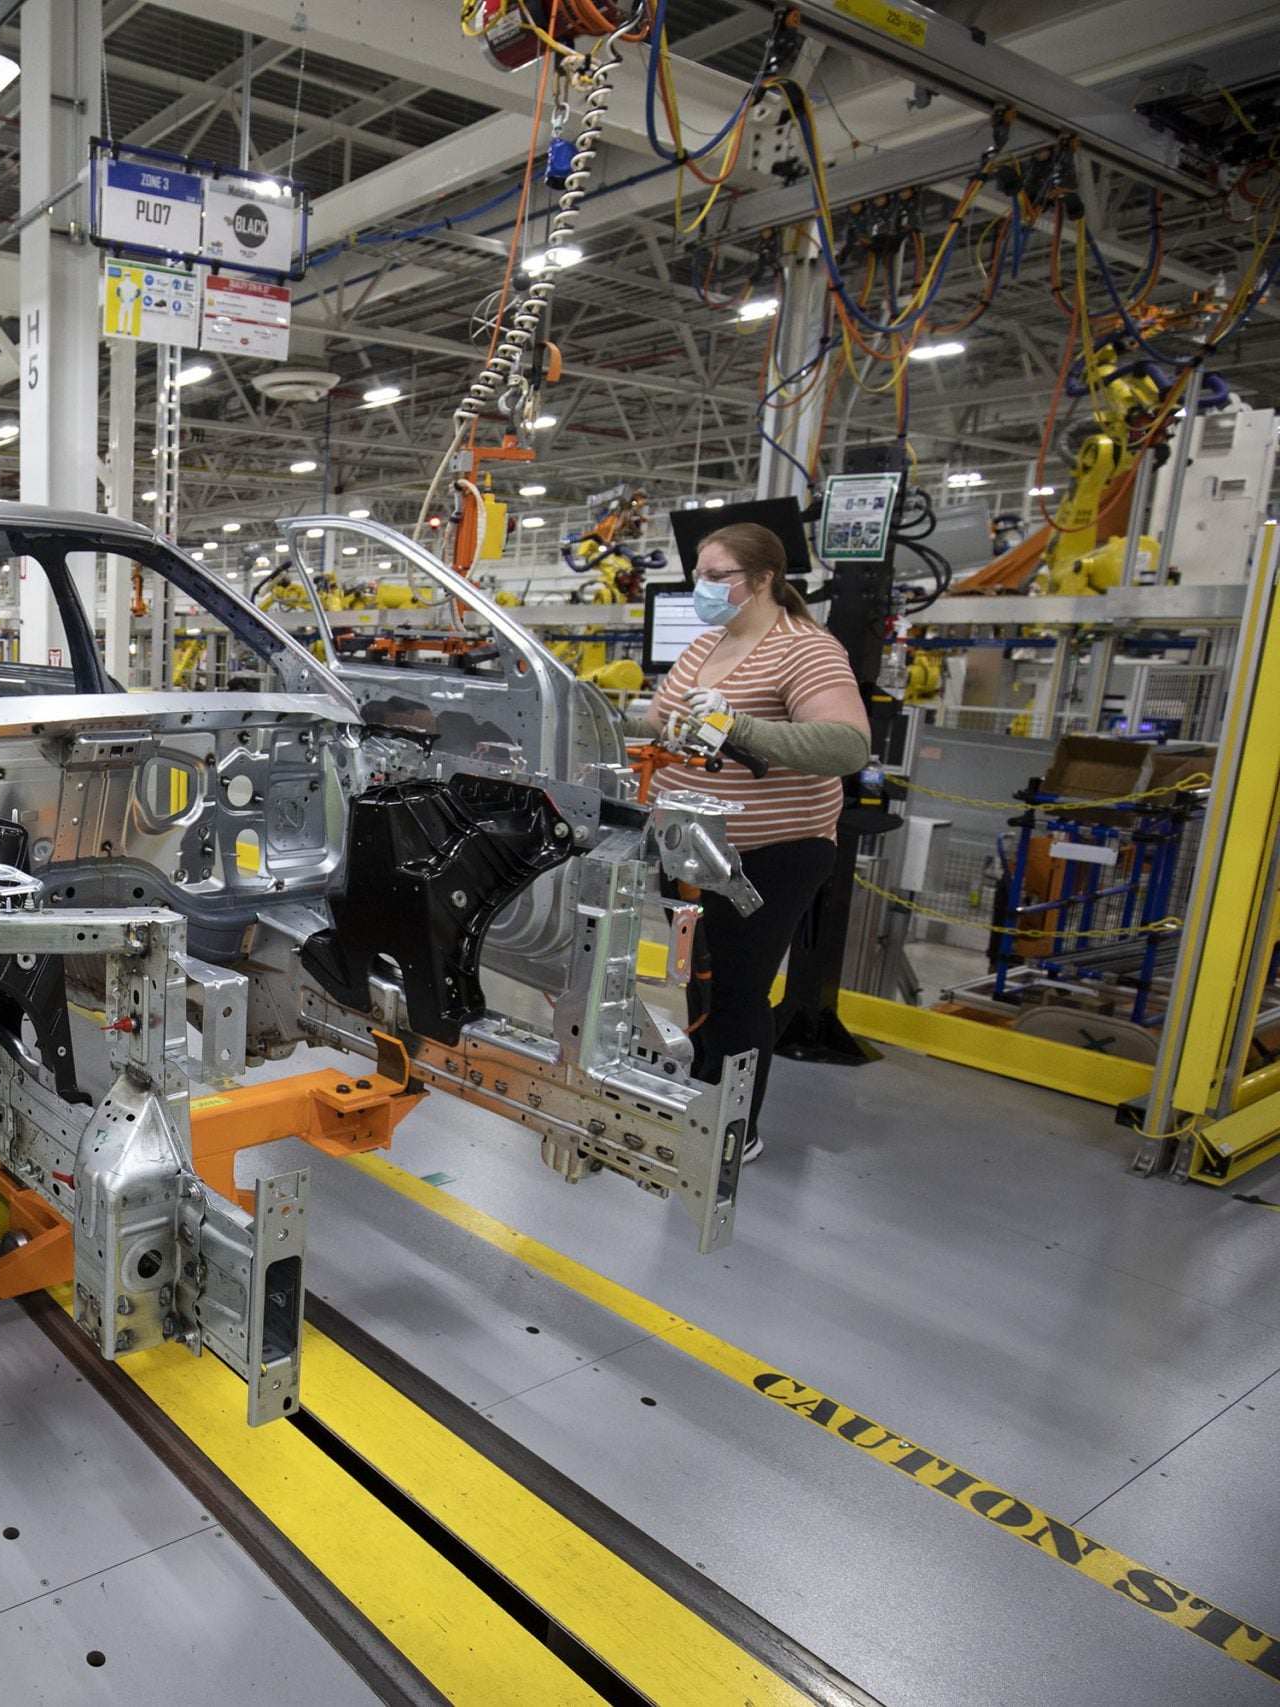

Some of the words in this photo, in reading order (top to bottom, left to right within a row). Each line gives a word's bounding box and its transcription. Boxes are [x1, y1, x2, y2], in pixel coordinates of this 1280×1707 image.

[140, 173, 163, 188] ZONE
[163, 177, 170, 191] 3
[136, 199, 171, 226] PL07
[235, 215, 268, 237] BLACK
[752, 1372, 1108, 1566] CAUTION
